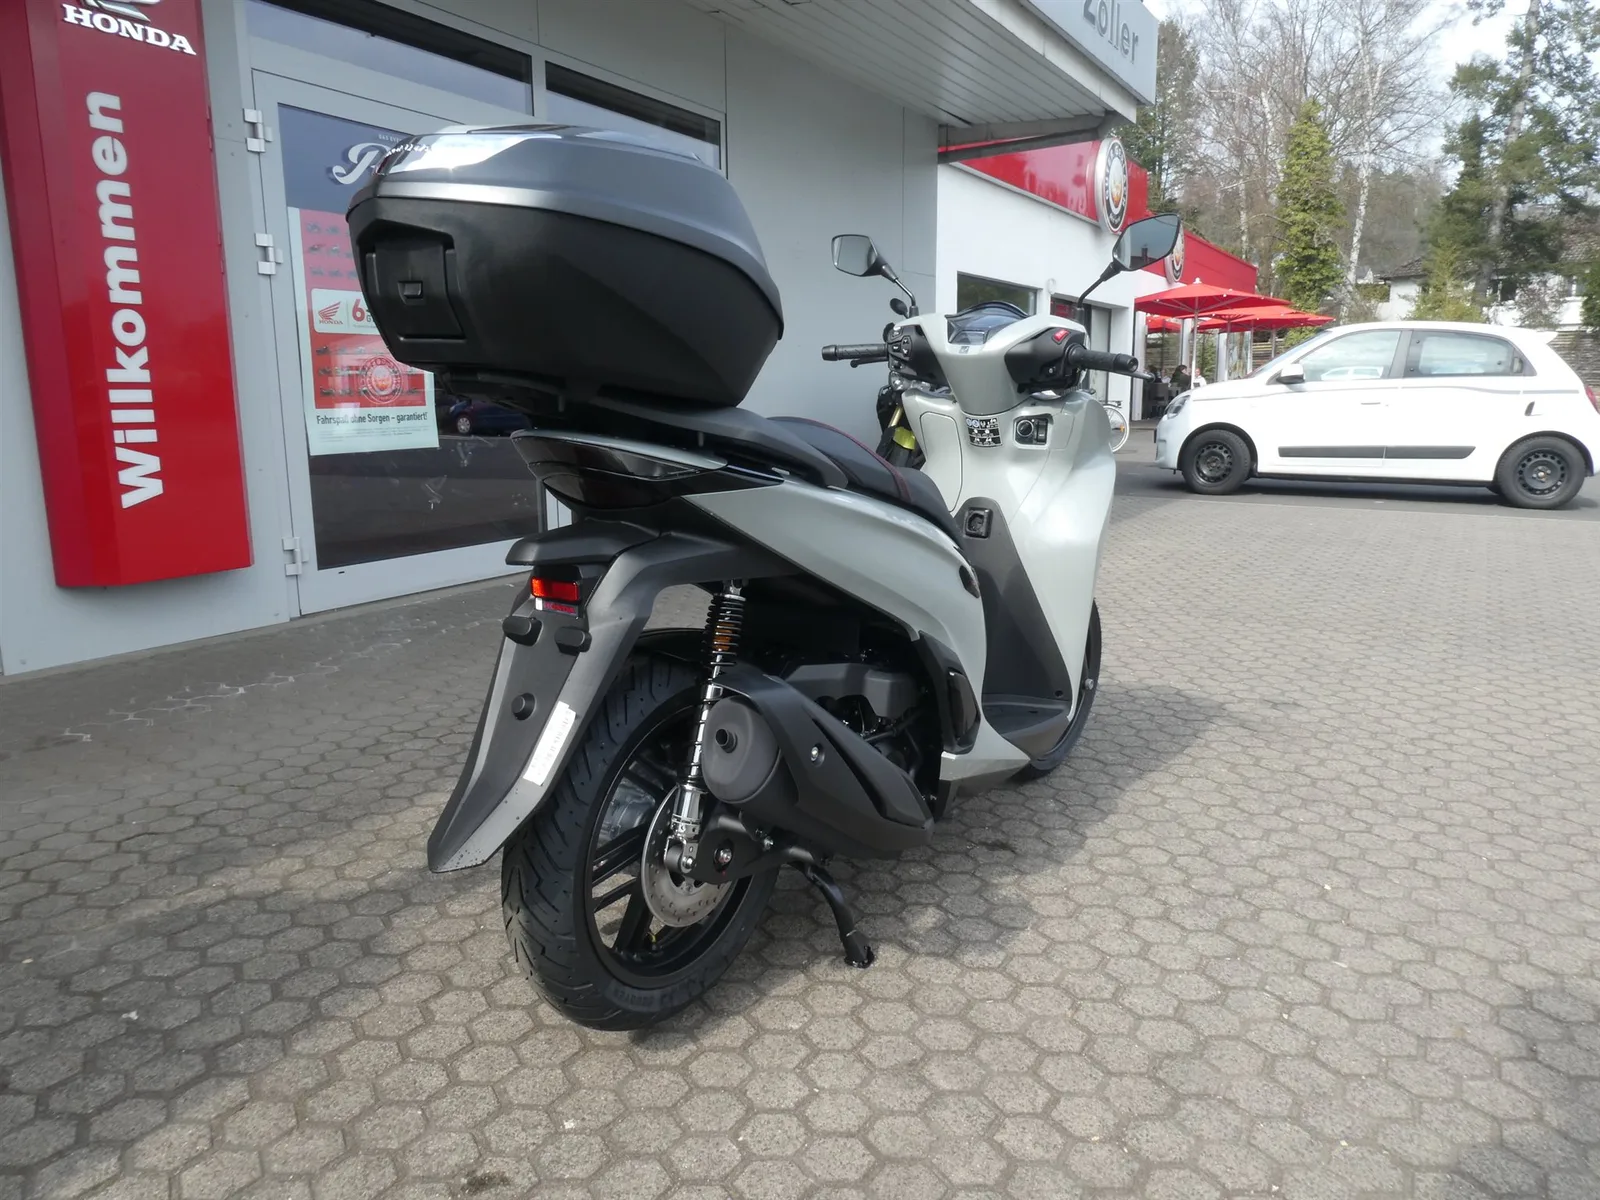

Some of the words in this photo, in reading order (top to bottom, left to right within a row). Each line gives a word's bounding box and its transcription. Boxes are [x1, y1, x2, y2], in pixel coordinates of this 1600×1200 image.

[62, 4, 197, 56] HONDA
[86, 91, 164, 509] Willkommen
[352, 298, 366, 322] 6
[351, 413, 366, 423] ohne
[367, 413, 390, 424] Sorgen
